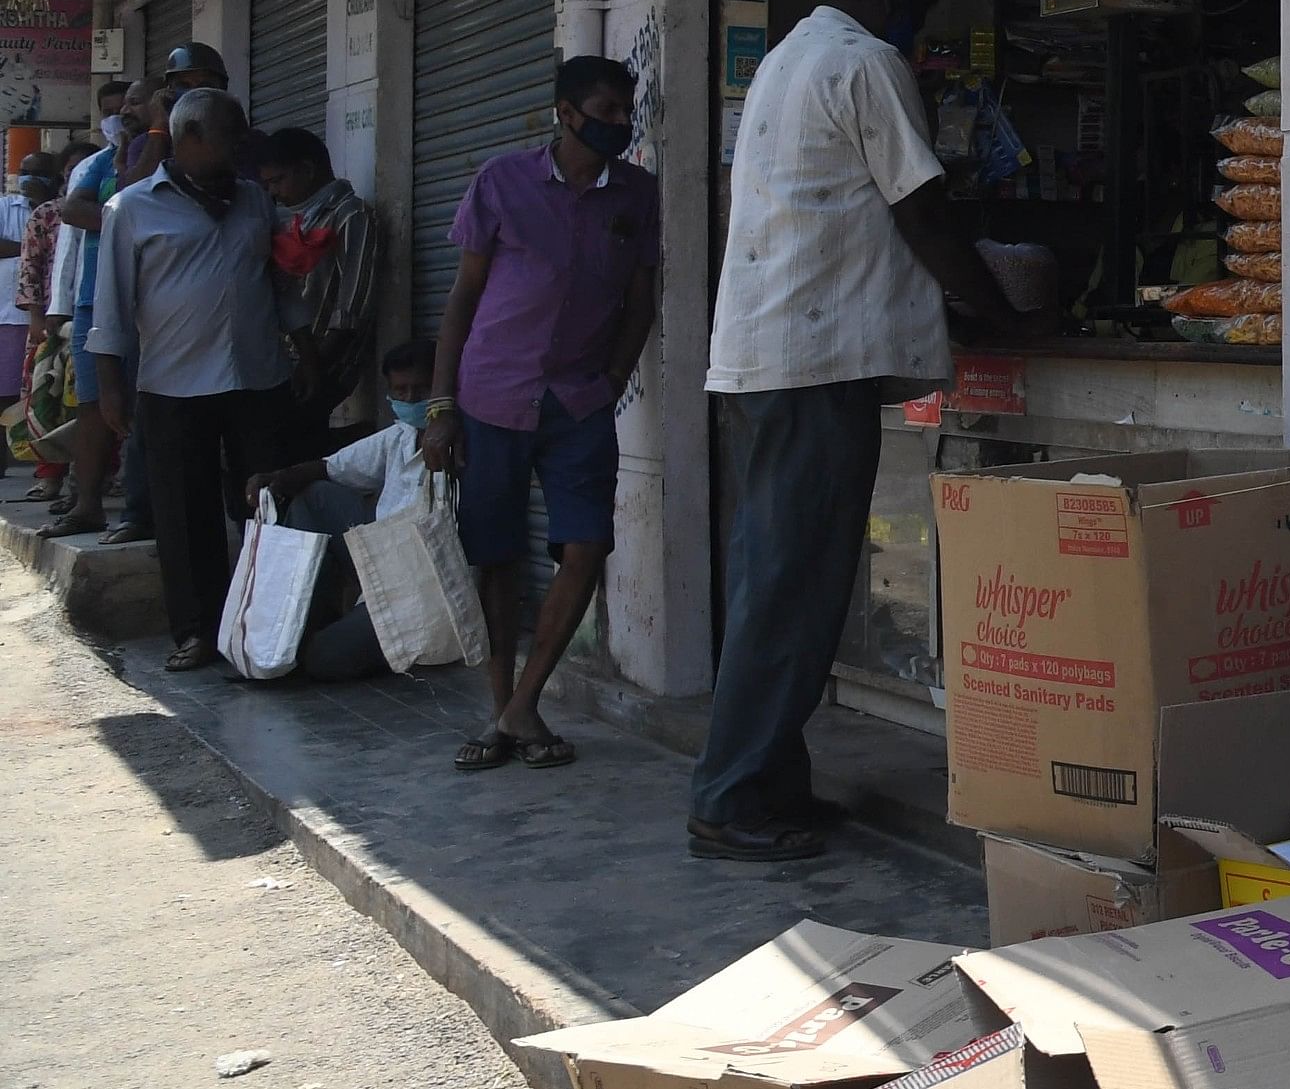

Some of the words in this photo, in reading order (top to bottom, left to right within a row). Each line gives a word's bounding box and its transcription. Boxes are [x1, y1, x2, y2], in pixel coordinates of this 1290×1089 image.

[941, 482, 970, 512] P&G
[1186, 508, 1204, 526] UP
[1094, 531, 1110, 541] 120
[975, 565, 1066, 628] whisper
[977, 612, 1028, 650] choice
[1008, 656, 1030, 674] pads
[1040, 660, 1059, 676] 120
[1061, 664, 1112, 683] polybags
[963, 674, 1011, 698] Scented
[1013, 683, 1072, 711] Sanitary
[1075, 692, 1115, 713] Pads
